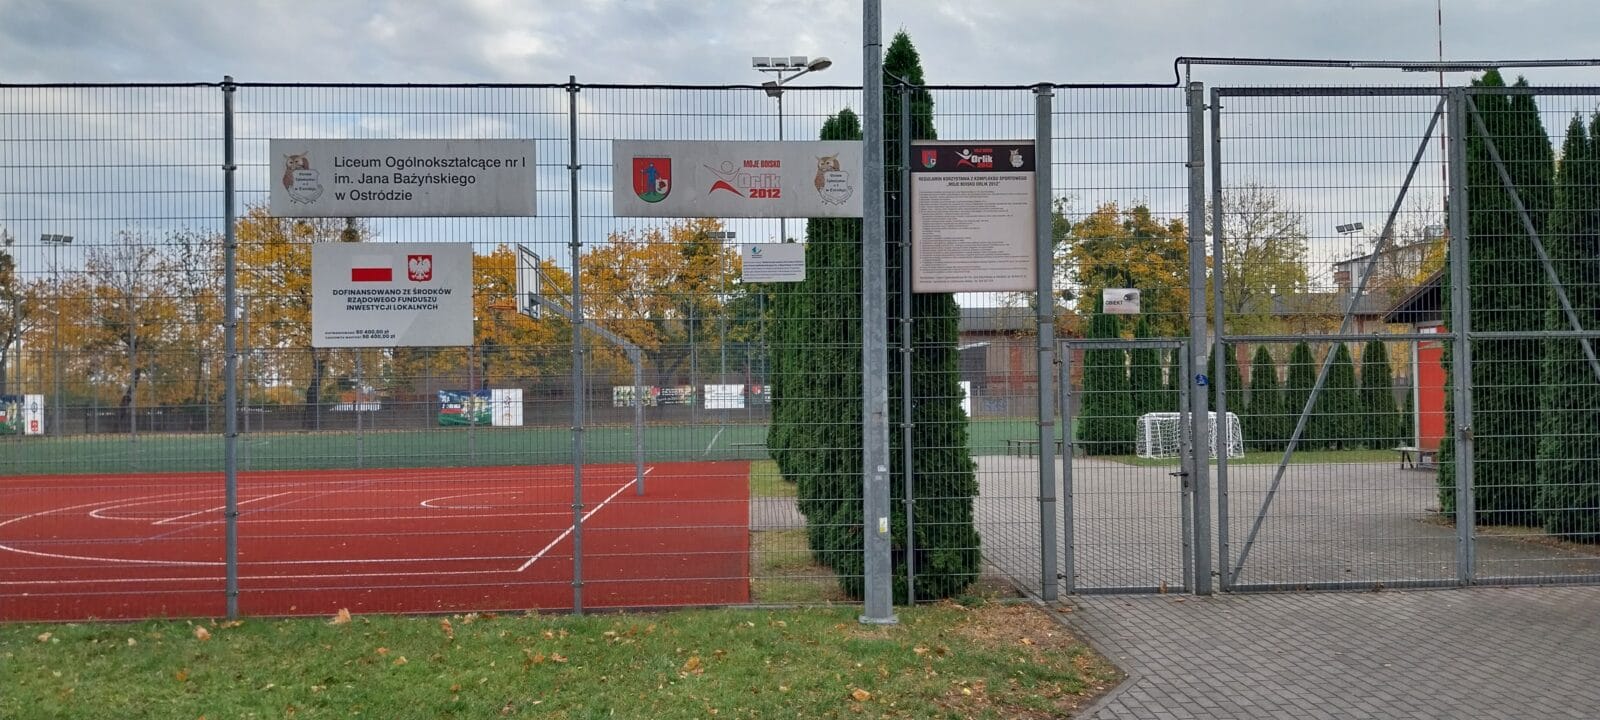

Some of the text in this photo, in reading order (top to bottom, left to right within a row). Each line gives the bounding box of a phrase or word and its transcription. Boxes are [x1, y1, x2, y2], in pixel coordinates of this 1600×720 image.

[334, 156, 381, 168] Liceum
[385, 156, 501, 171] Ogólnokształcące
[505, 158, 518, 168] nr
[743, 159, 781, 168] MOJE BOISKO
[971, 154, 993, 163] Orlik
[334, 172, 476, 187] im. Jana Bażyńskiego
[738, 173, 781, 188] Orlik
[334, 189, 413, 201] w Ostródzie
[749, 188, 781, 199] 2012
[412, 287, 452, 295] ŚRODKÓW
[347, 296, 396, 304] RZĄDOWEGO
